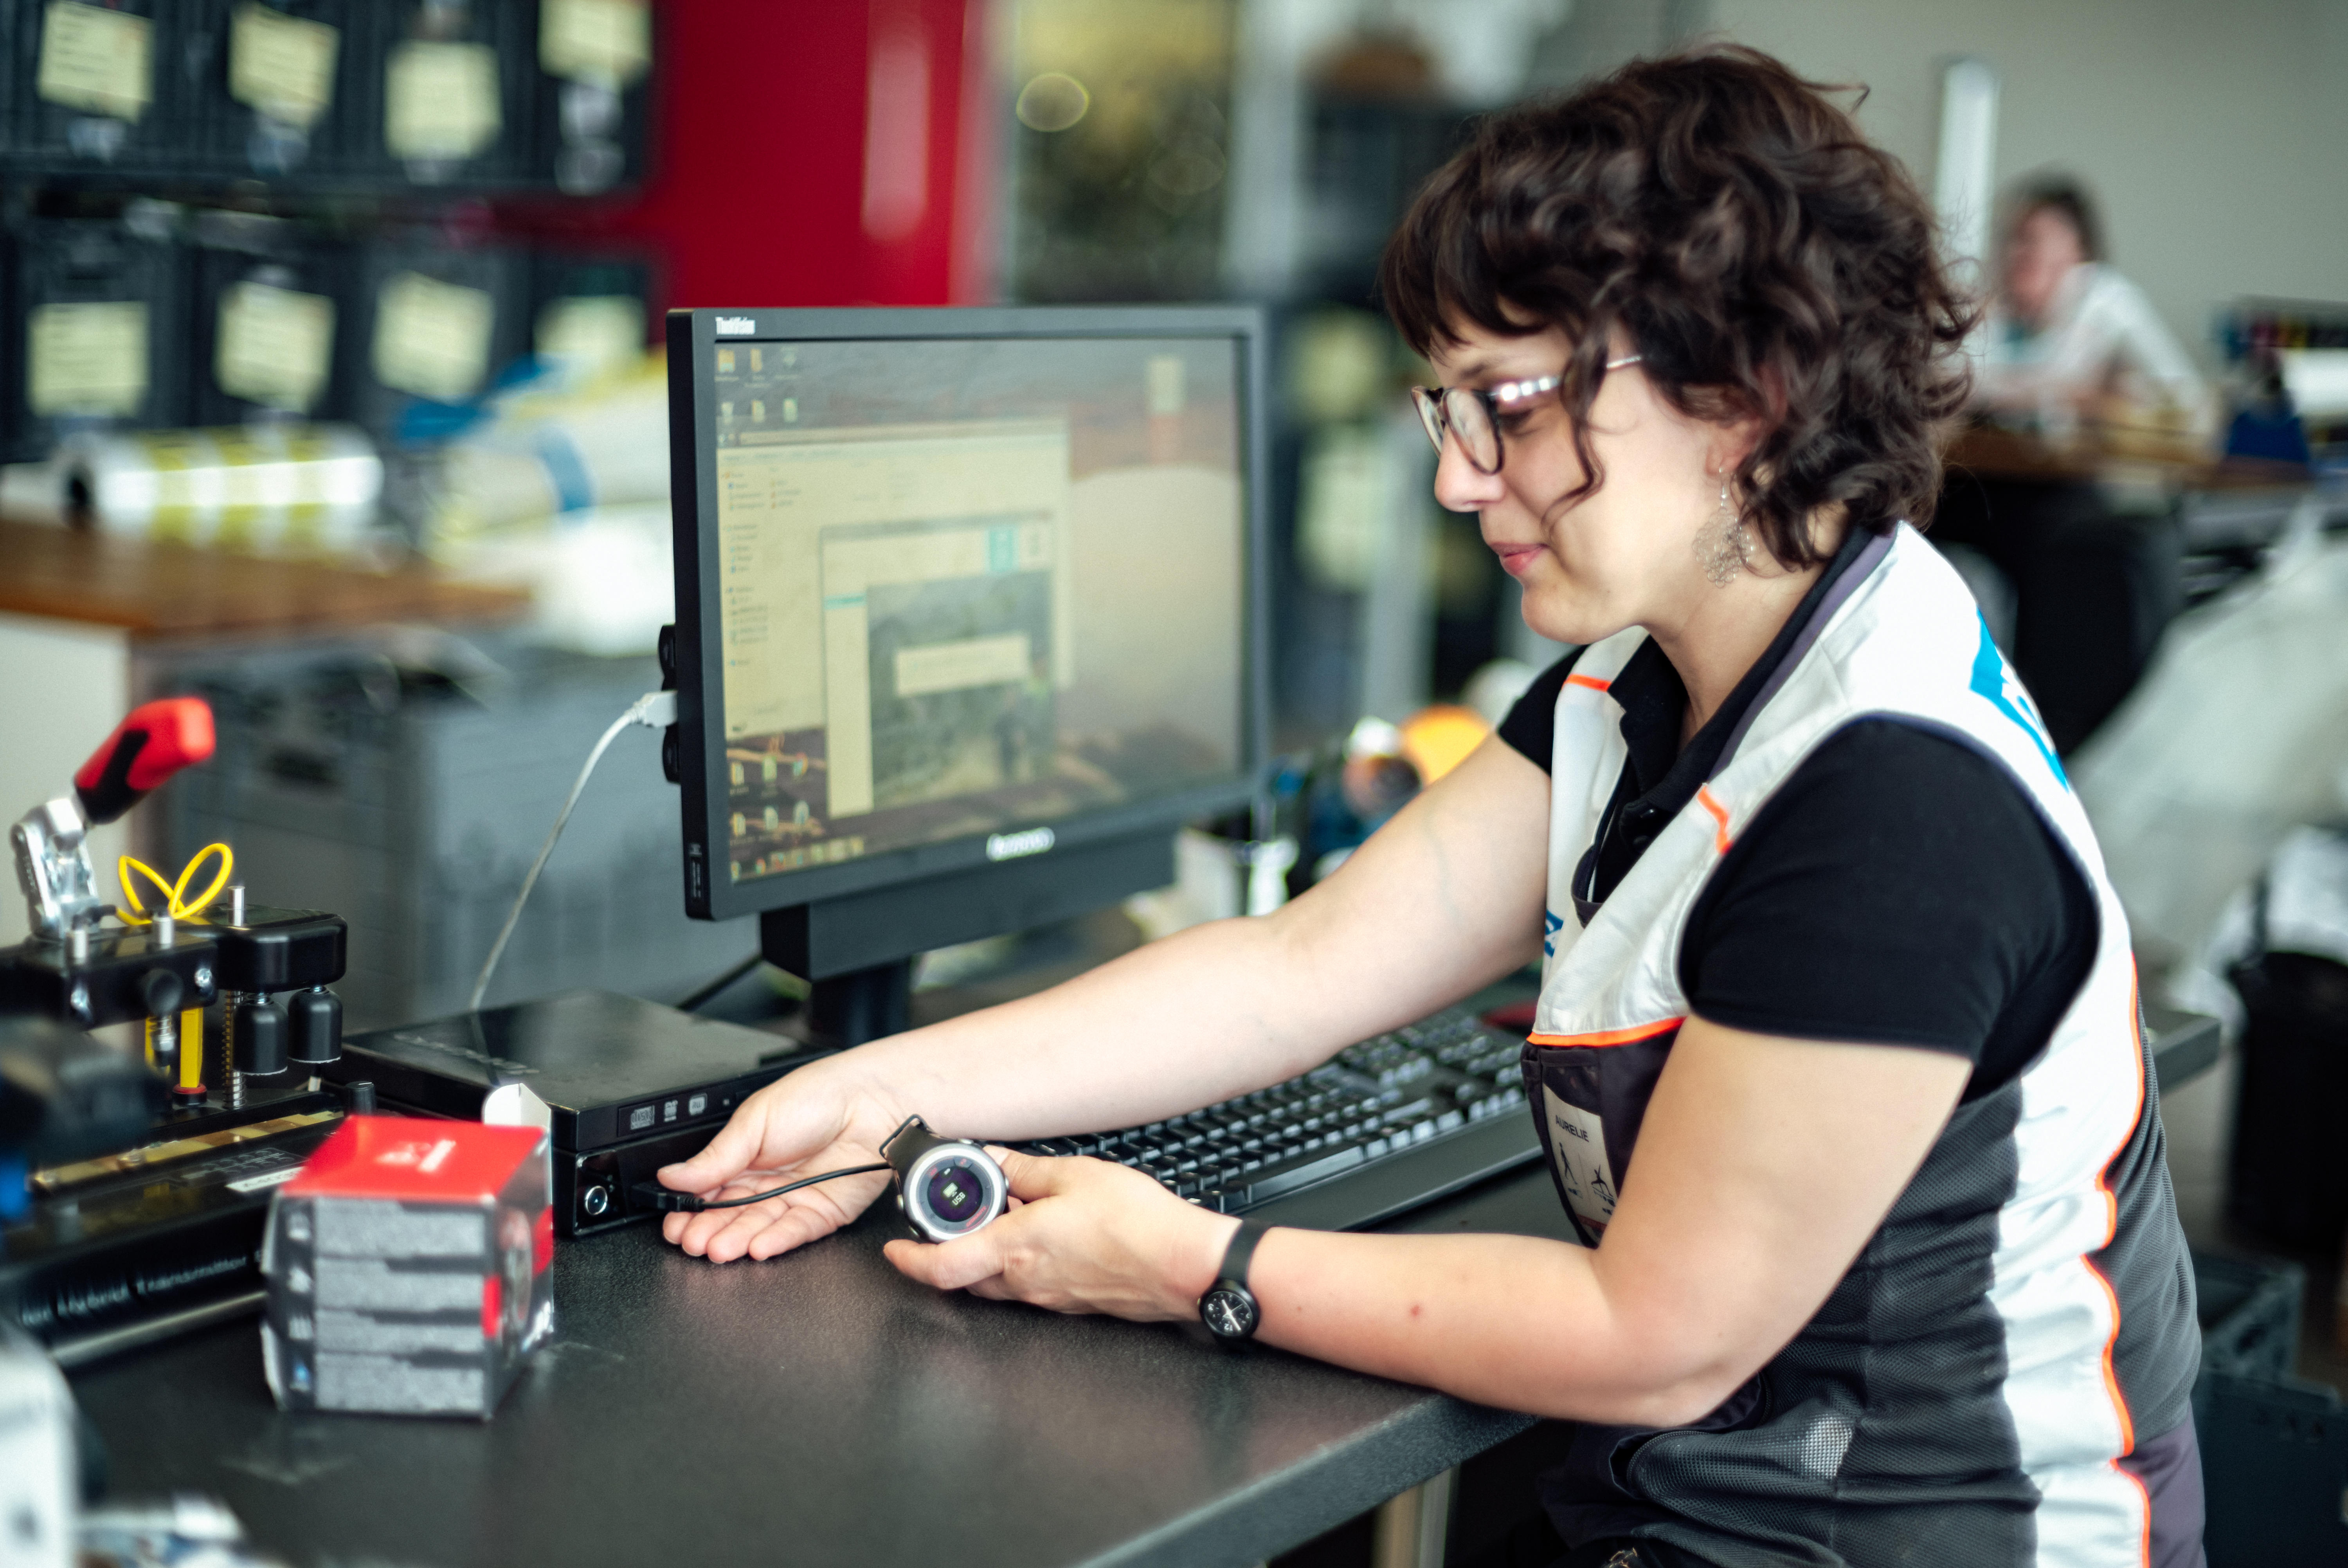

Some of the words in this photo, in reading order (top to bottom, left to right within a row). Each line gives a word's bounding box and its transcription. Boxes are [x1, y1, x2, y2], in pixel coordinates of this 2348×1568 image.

[1556, 1115, 1590, 1143] AURELIE
[952, 1192, 965, 1205] USB
[1224, 1323, 1233, 1331] 12
